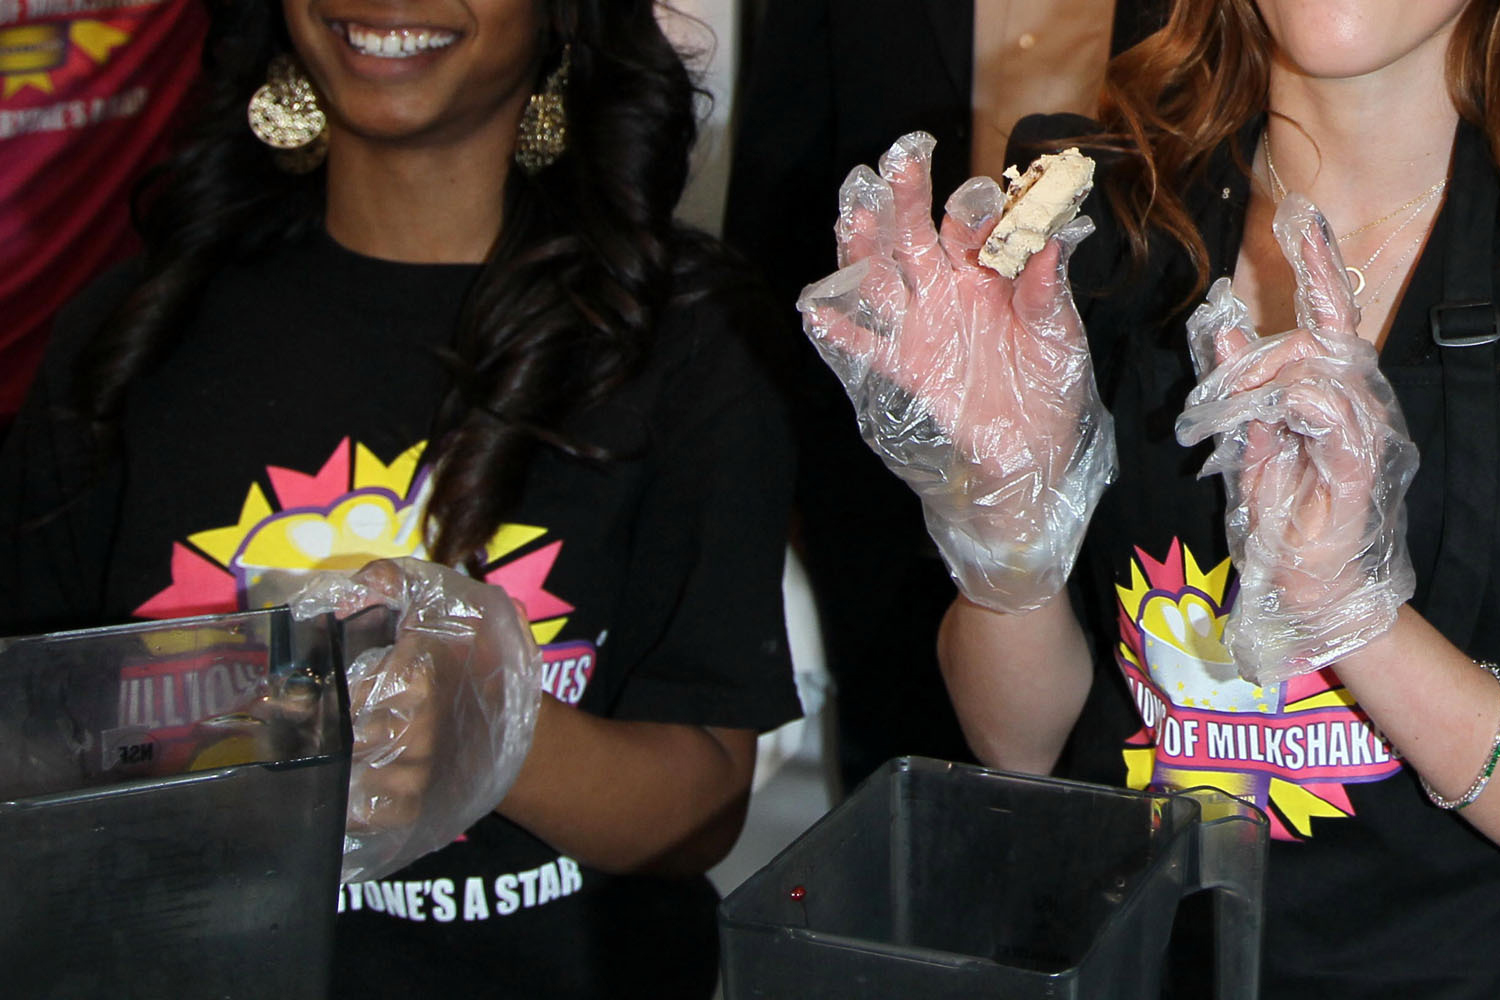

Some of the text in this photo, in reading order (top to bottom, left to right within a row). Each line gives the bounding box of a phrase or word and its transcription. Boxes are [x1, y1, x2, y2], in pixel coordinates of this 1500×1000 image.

[1164, 715, 1199, 757] OF
[1207, 721, 1395, 770] MILKSHAKE
[463, 877, 490, 921] A
[495, 855, 584, 917] STAR
